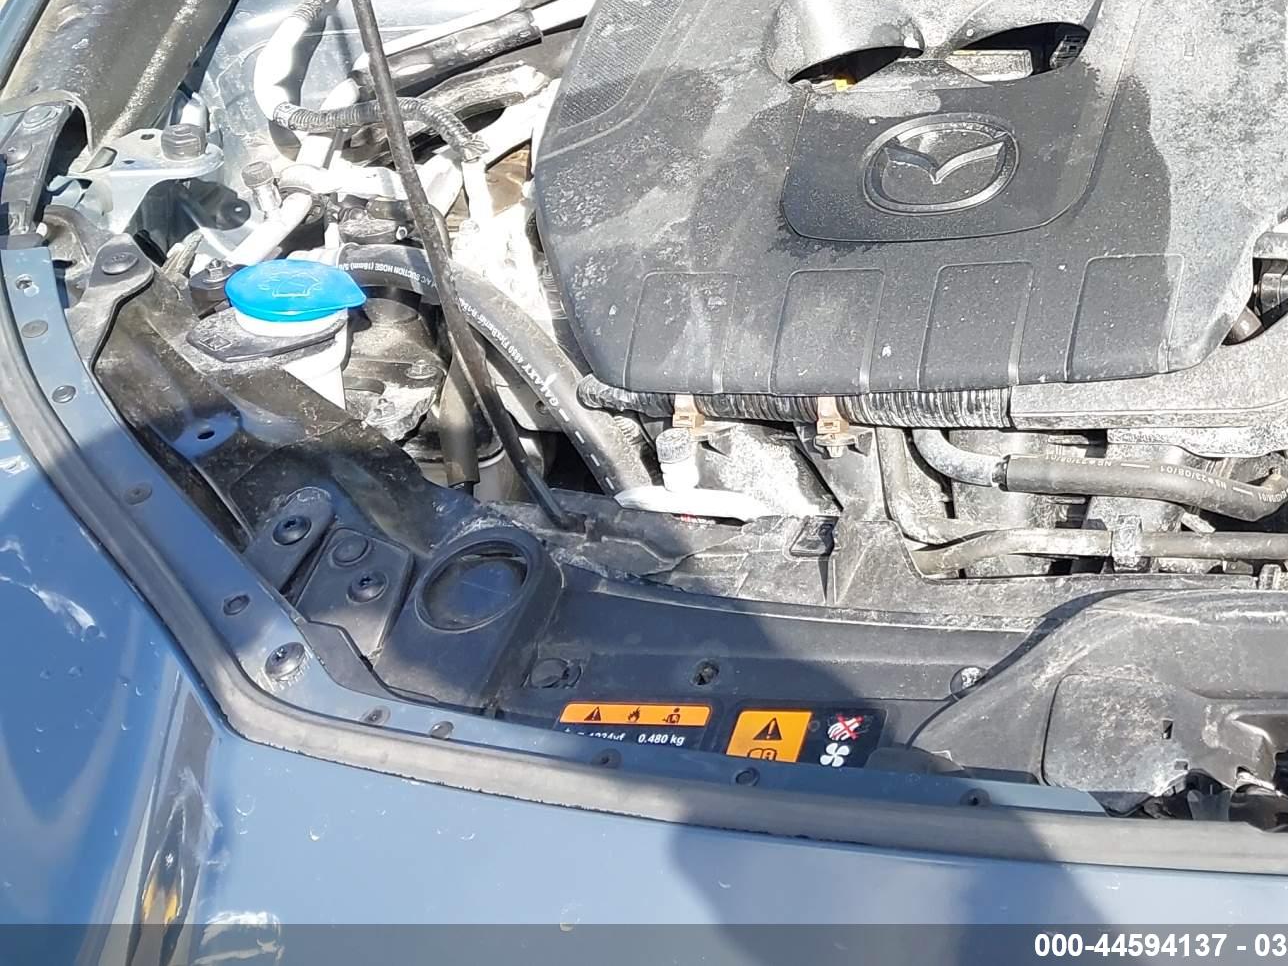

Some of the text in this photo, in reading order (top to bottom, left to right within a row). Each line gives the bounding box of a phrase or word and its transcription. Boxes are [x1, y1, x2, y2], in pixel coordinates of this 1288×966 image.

[375, 262, 394, 273] HOSE
[393, 266, 421, 282] SUCTION
[522, 363, 560, 407] GALAXY
[638, 733, 668, 744] 0.480
[670, 734, 686, 746] kg
